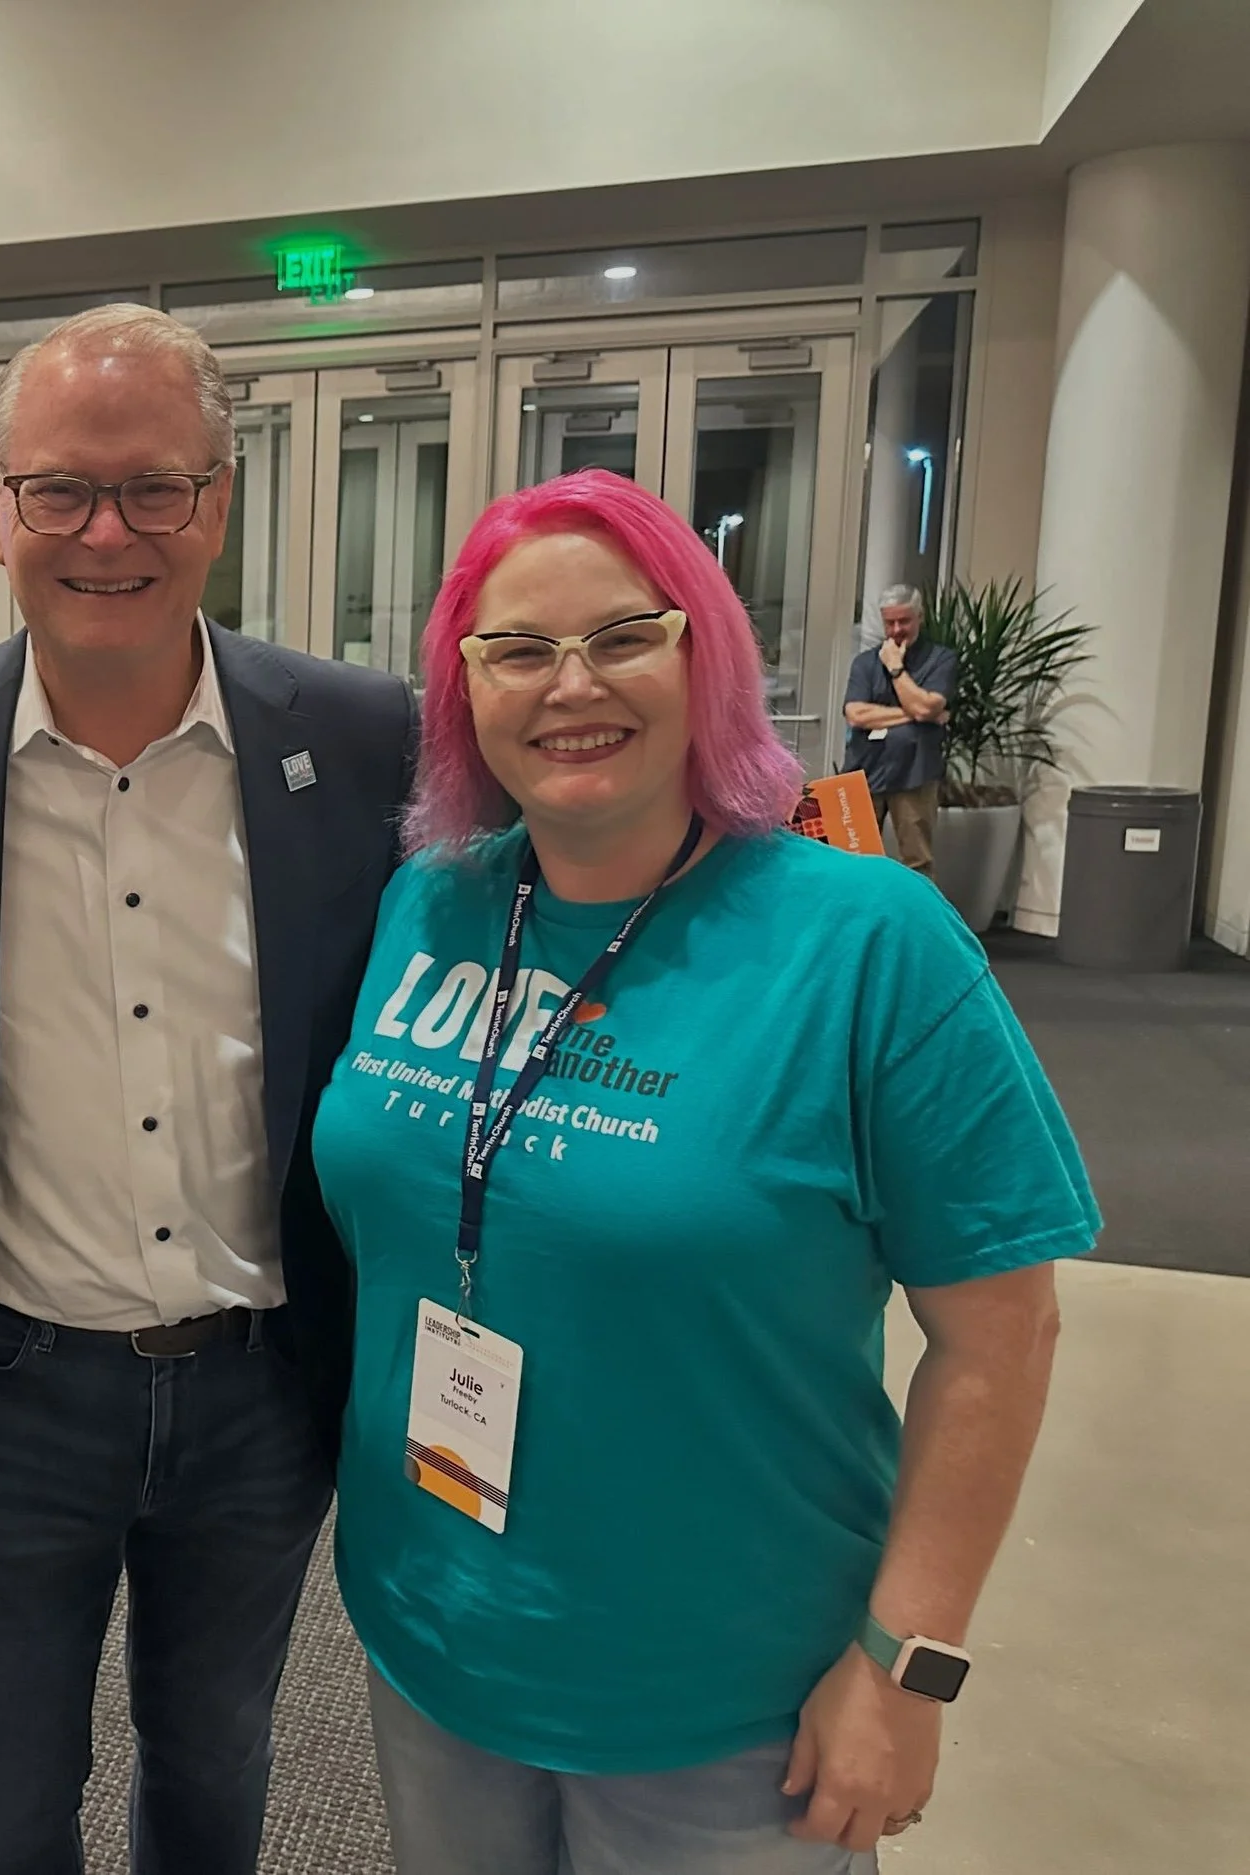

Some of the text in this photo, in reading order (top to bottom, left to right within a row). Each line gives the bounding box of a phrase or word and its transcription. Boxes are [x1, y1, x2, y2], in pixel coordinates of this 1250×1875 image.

[285, 247, 335, 288] EXIT
[285, 754, 311, 776] LOVE
[837, 786, 852, 826] Thomas
[374, 951, 575, 1072] LOVE
[352, 1051, 659, 1144] First United Mthdist Church
[425, 1316, 461, 1338] LEADERSHIP
[450, 1368, 484, 1396] Julie
[474, 1412, 487, 1425] CA
